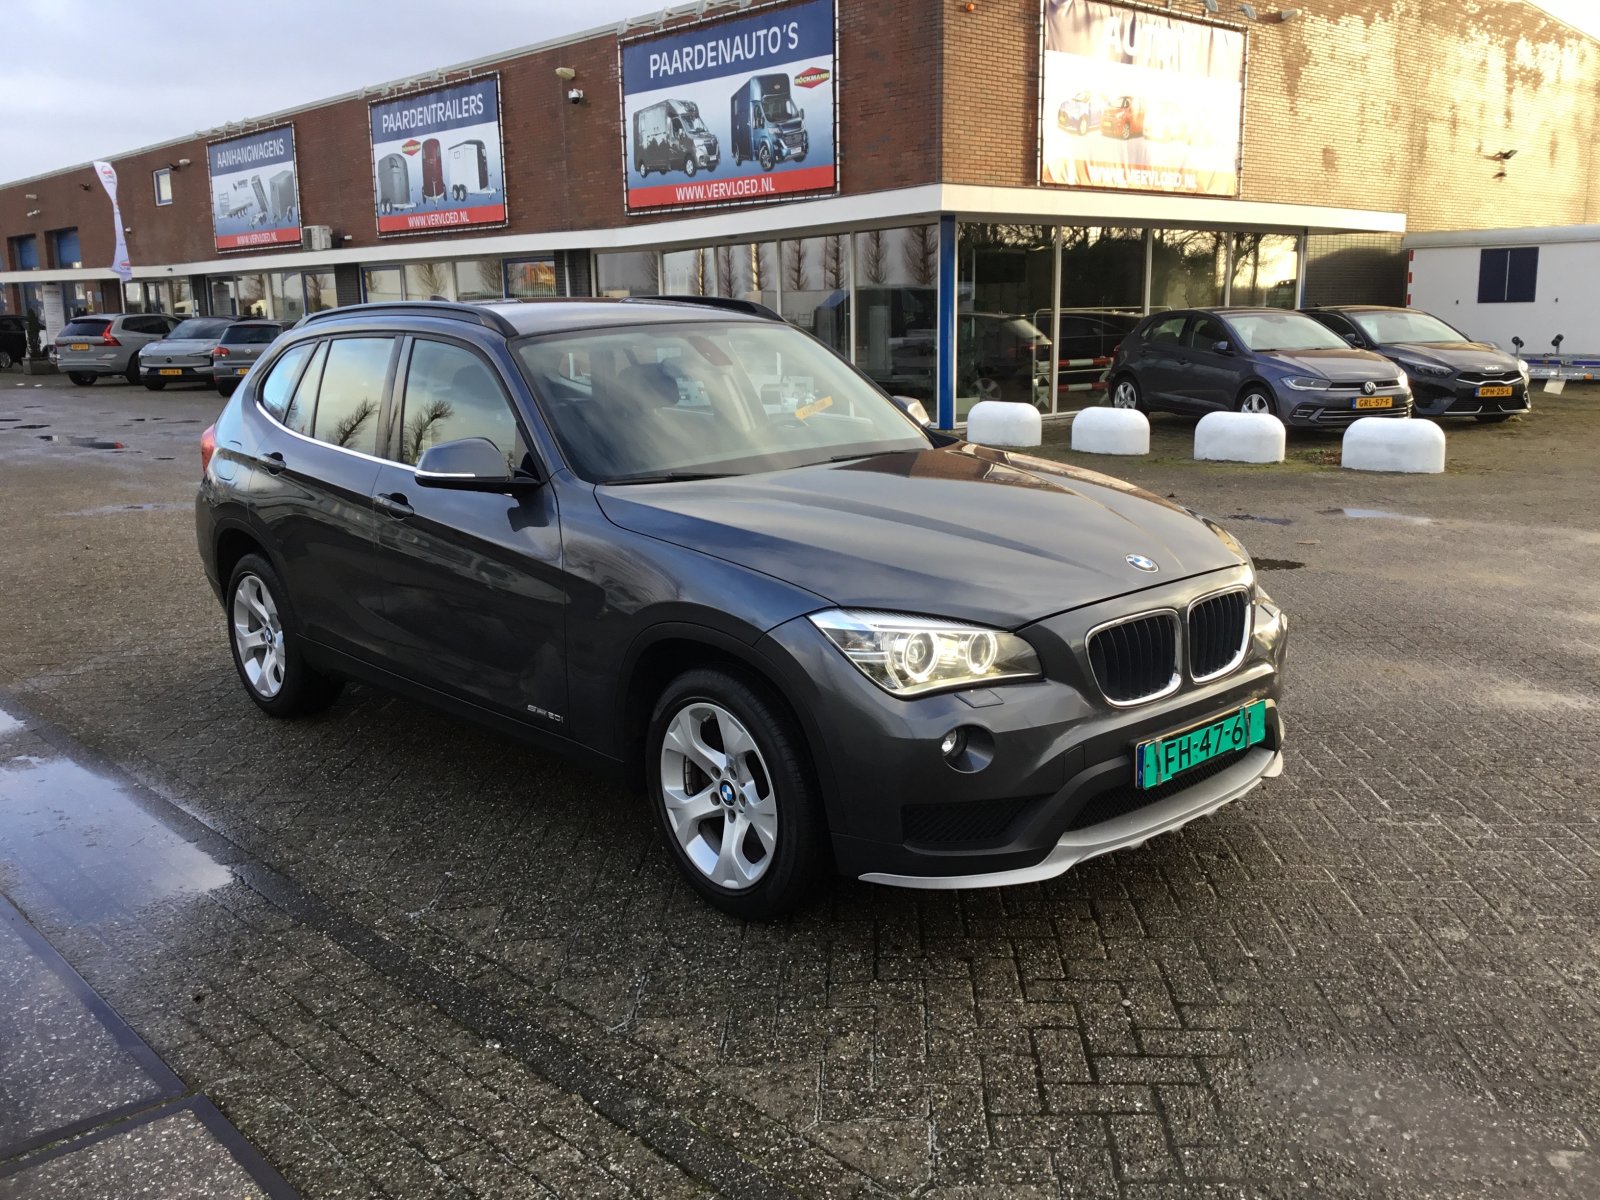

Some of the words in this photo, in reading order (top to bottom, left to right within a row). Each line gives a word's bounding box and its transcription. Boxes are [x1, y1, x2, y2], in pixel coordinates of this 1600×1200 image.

[649, 21, 799, 79] PAARDENAUTO'S
[382, 93, 484, 134] PAARDENTRAILERS
[217, 138, 285, 168] AANHANGWAGENS
[675, 177, 776, 201] WWW.VERVLOED.NL
[407, 210, 470, 228] WWW.VERVLOED.NL
[1358, 398, 1391, 408] GRL-57-F
